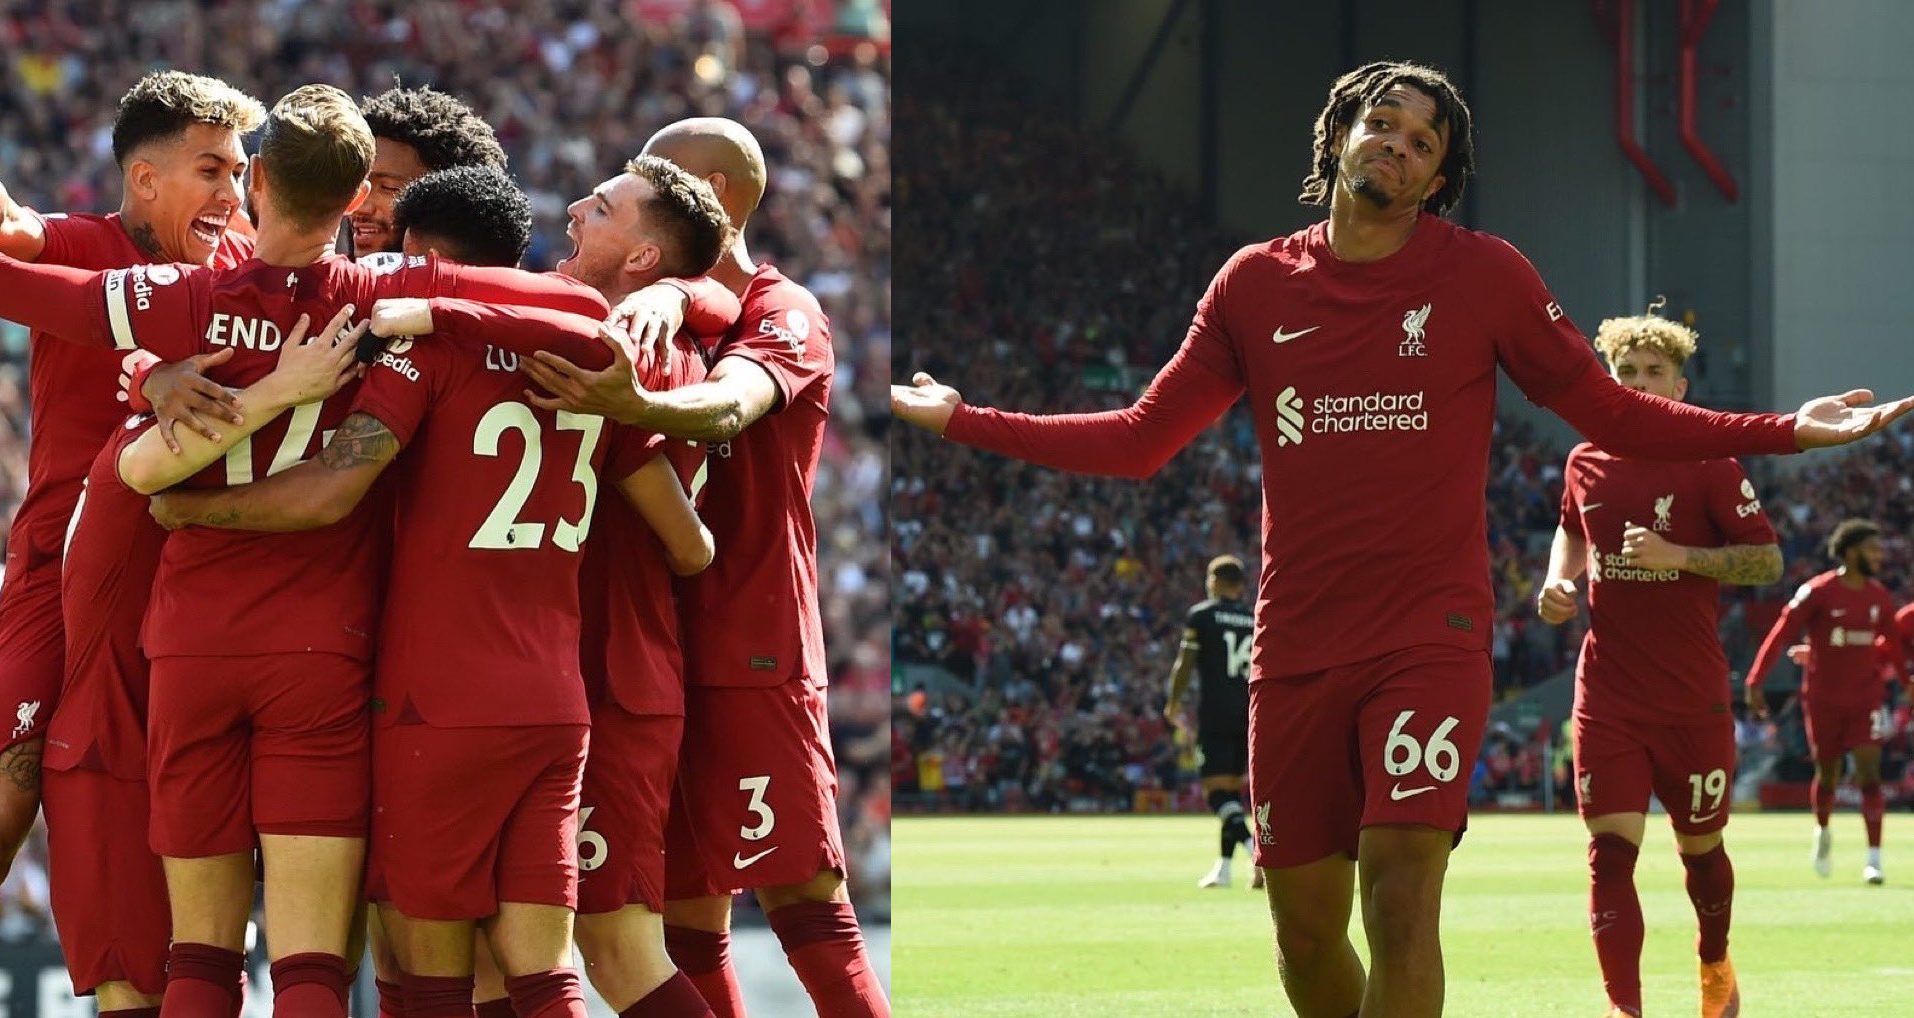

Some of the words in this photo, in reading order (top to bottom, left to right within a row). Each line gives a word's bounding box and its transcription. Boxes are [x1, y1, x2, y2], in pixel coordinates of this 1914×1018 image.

[1311, 411, 1428, 433] chartered
[1313, 390, 1424, 414] standard
[468, 401, 604, 553] 23
[1604, 565, 1679, 581] chartered
[1383, 710, 1460, 782] 66
[739, 775, 775, 841] 3
[1688, 768, 1727, 812] 19
